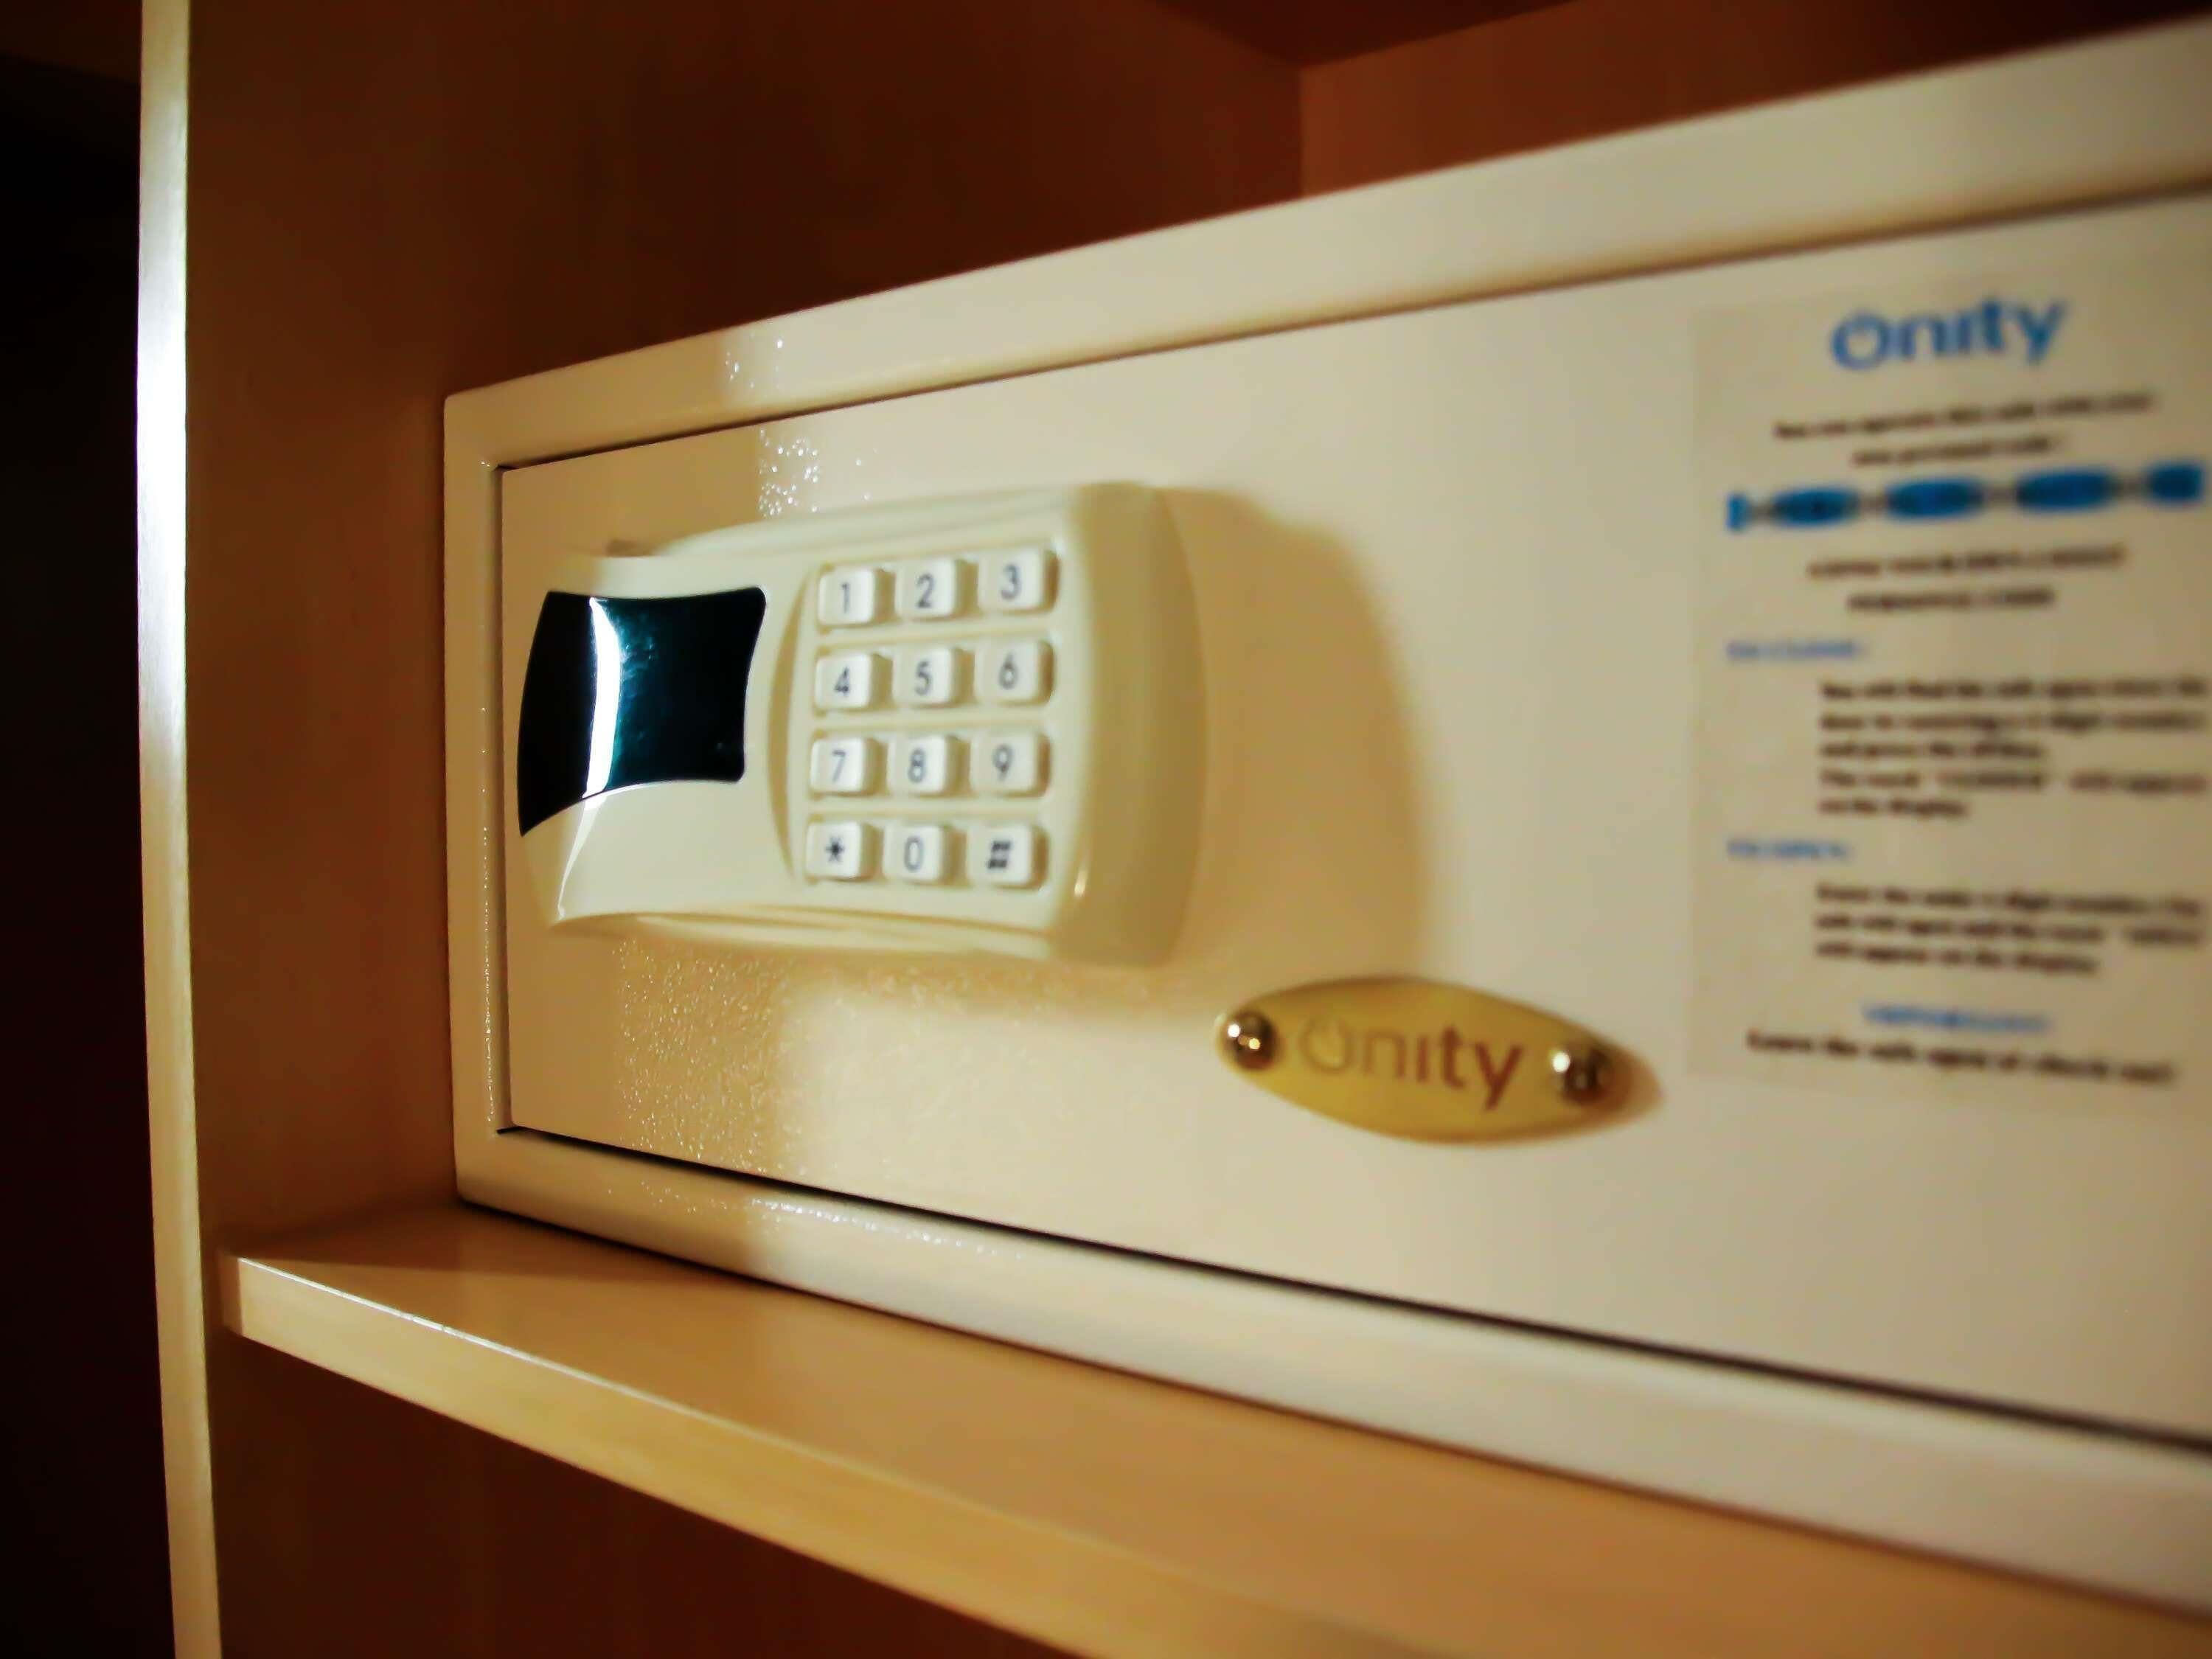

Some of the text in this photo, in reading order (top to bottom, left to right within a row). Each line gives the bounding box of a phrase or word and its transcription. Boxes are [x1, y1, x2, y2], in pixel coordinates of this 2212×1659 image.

[1830, 297, 2069, 371] Onity
[840, 564, 1022, 613] 1 2 3
[833, 653, 1019, 697] 4 5 6
[832, 744, 1015, 784] 7 8 9
[902, 836, 925, 872] 0
[987, 840, 1013, 870] #
[1298, 1015, 1523, 1112] Onity
